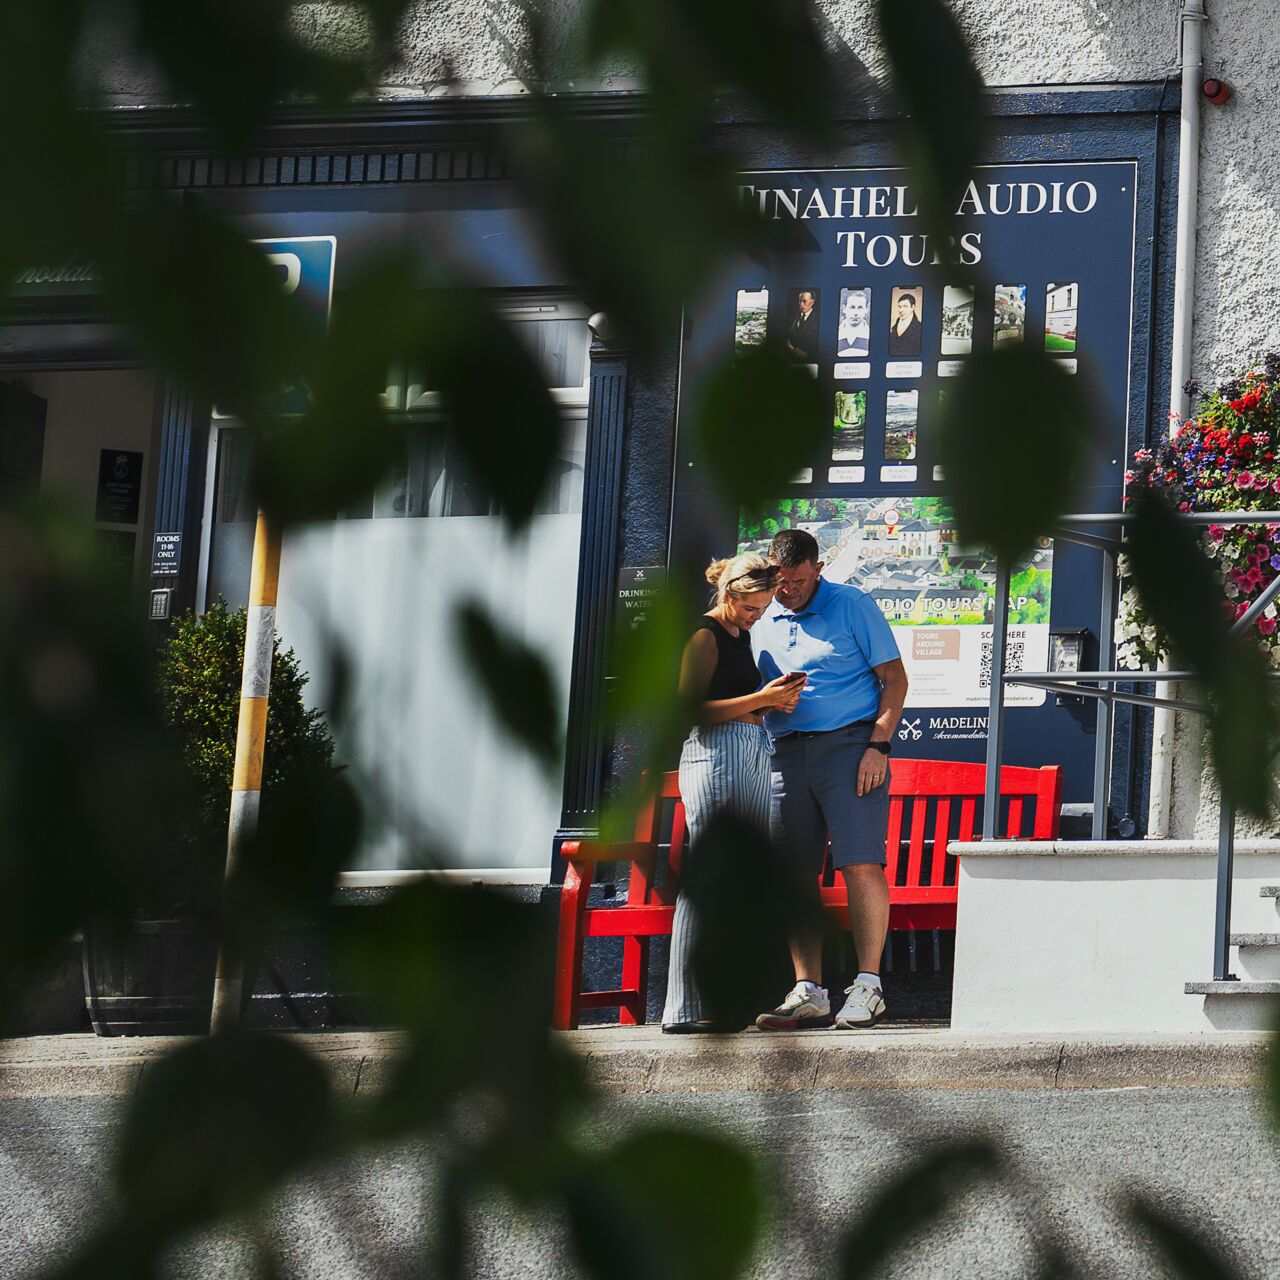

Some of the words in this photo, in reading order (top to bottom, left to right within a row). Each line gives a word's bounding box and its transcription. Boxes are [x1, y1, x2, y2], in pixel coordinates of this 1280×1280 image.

[736, 185, 918, 220] TINAHEL
[954, 179, 1098, 217] AUDIO
[156, 535, 180, 543] ROOMS
[157, 550, 176, 558] ONLY
[876, 597, 915, 613] DIO
[920, 596, 983, 612] TOURS
[916, 632, 939, 640] TOURS
[915, 640, 946, 648] AROUND
[915, 648, 943, 656] VILLAGE
[929, 717, 990, 729] MADELIN
